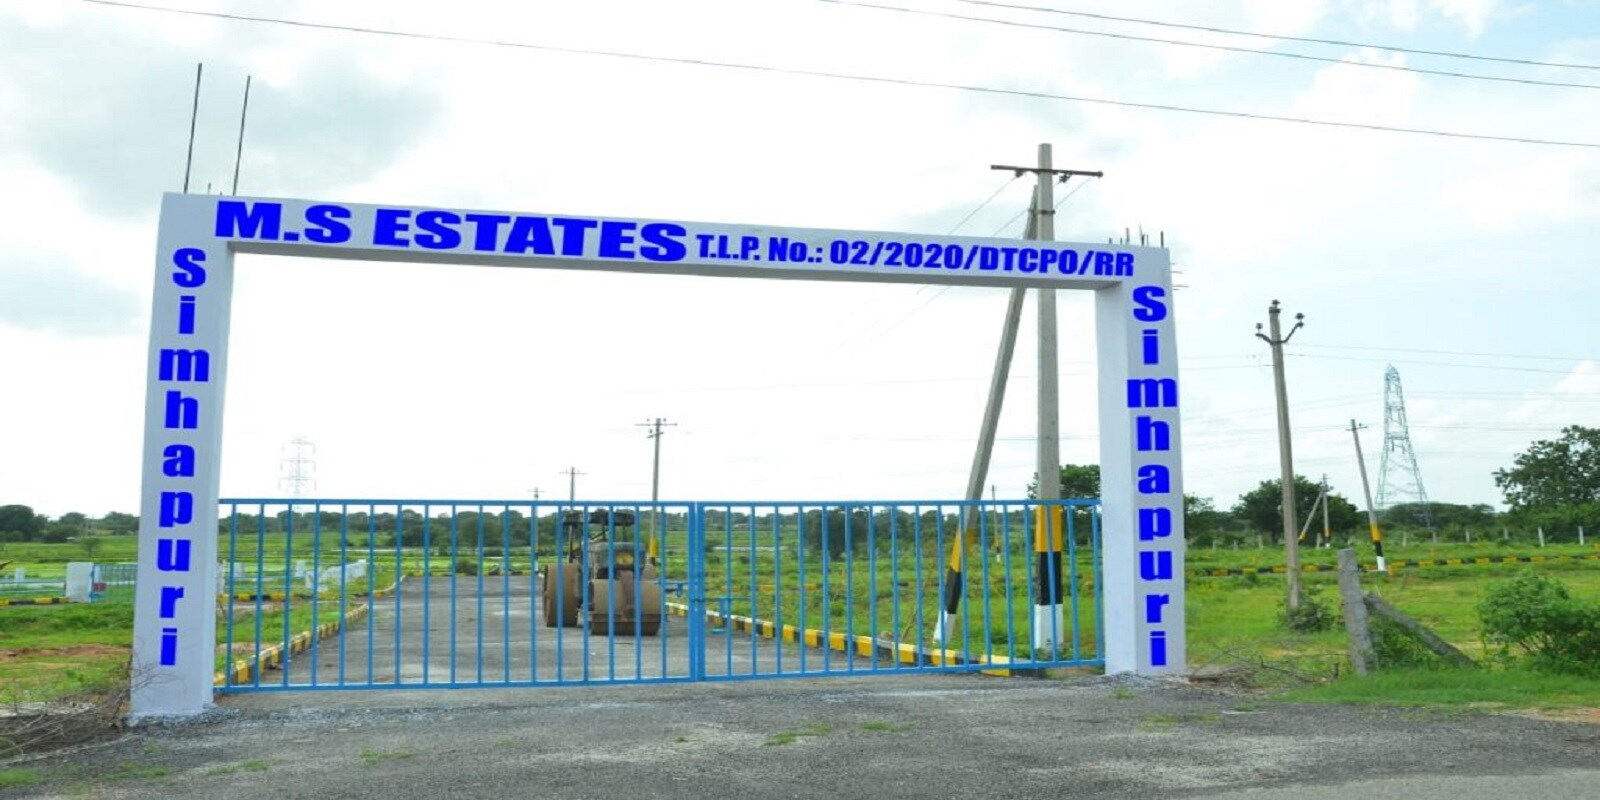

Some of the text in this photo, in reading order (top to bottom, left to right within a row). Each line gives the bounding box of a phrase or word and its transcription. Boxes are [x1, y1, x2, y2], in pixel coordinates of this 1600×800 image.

[214, 200, 1135, 278] M.S ESTATES T.L.P. No.: 02/2020/DTCPO/RR
[156, 247, 210, 667] Simhapuri
[1126, 285, 1178, 667] Simhapuri
